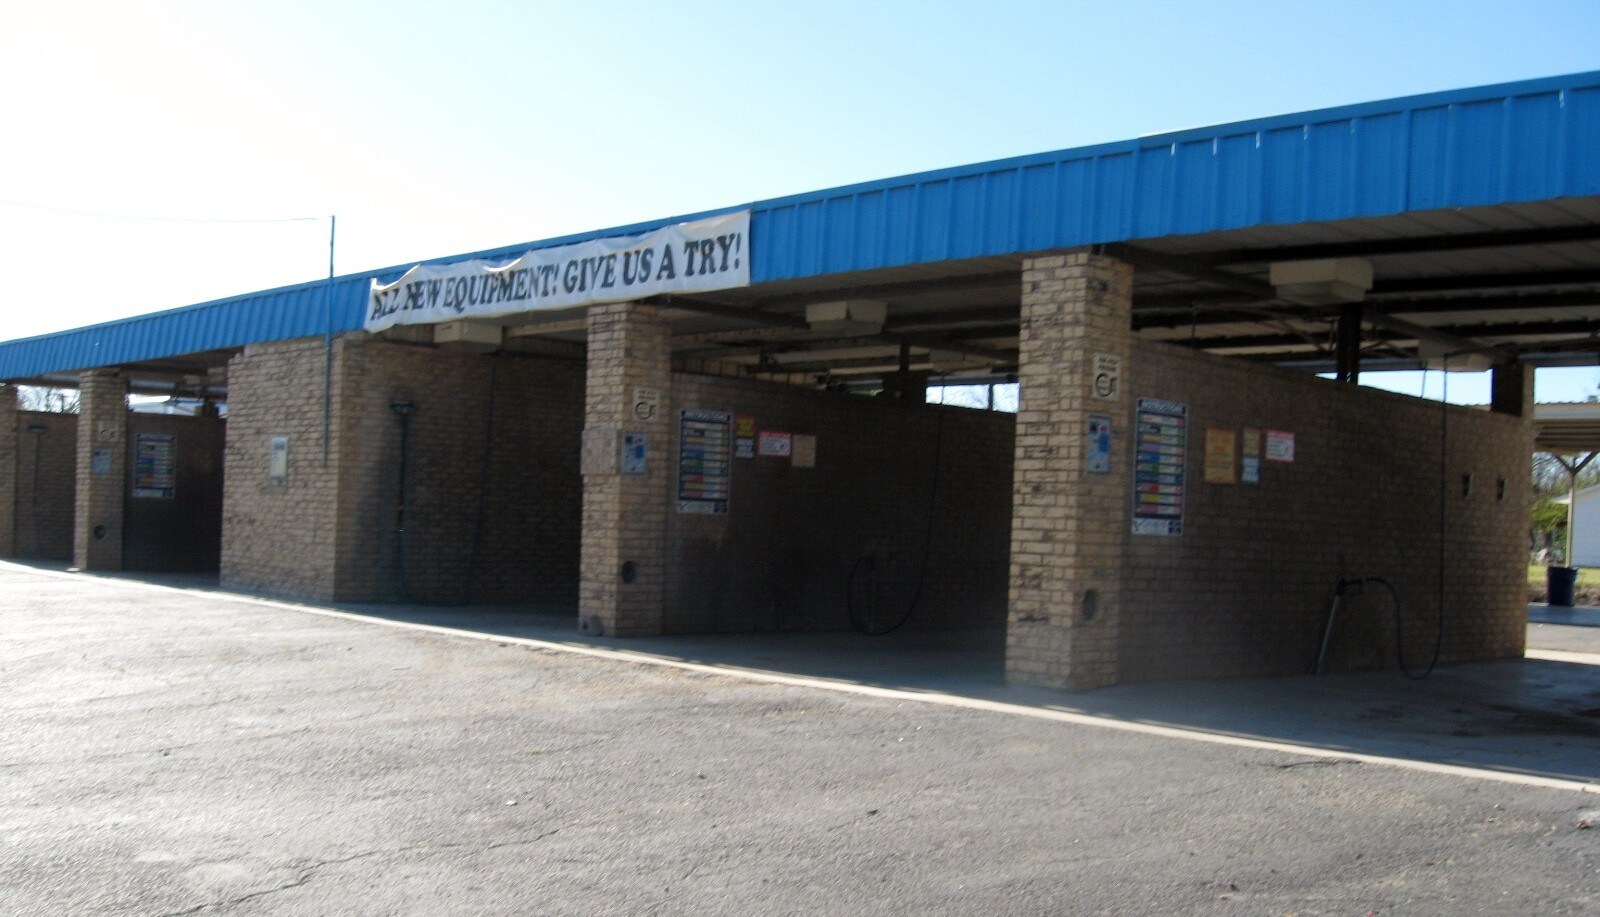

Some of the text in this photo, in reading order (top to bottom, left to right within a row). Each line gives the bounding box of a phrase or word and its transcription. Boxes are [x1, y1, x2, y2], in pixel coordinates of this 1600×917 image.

[370, 232, 742, 321] ALL NEW EQUIPMENT! GIVE US A TRY!
